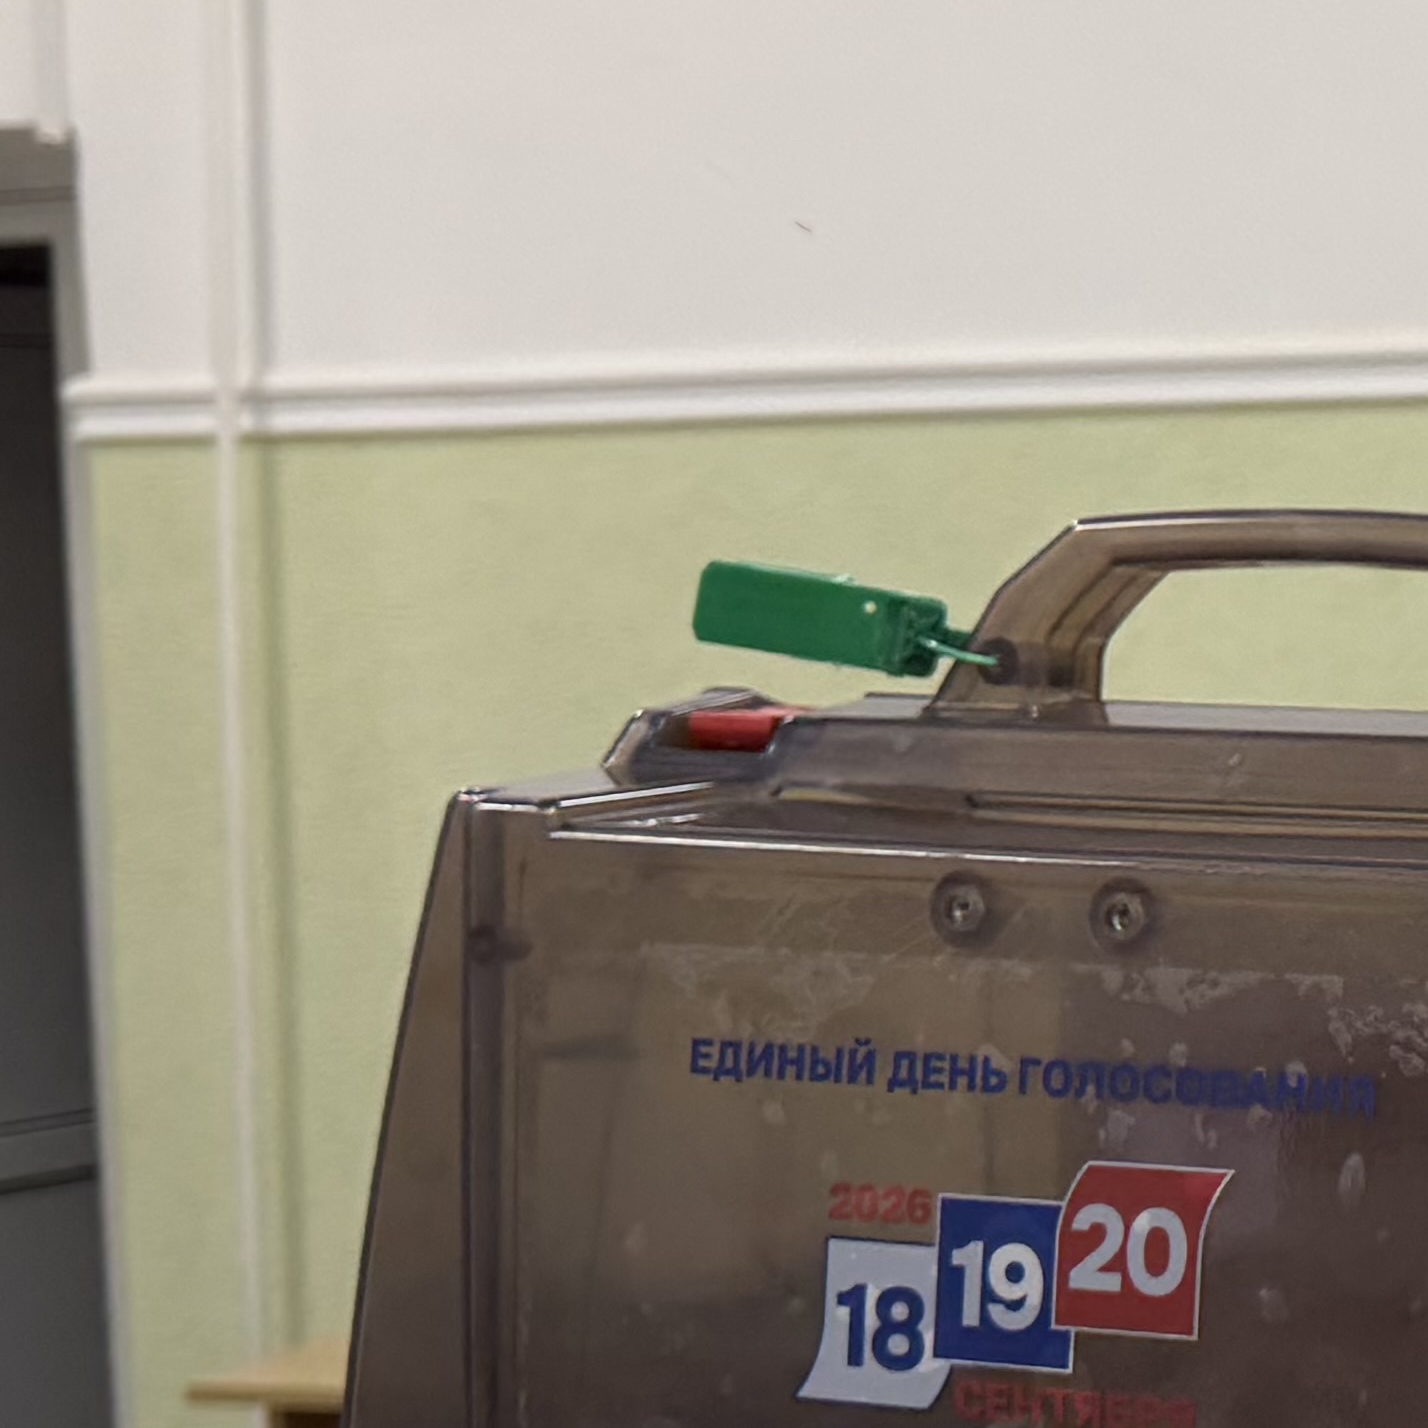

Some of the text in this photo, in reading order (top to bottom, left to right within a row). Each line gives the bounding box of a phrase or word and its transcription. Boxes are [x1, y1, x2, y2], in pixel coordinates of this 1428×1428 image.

[689, 1037, 1377, 1120] ЕДИНЫЙ ДЕНЬ ГОЛОСОВАНИЯ
[828, 1182, 932, 1225] 2026
[836, 1202, 1189, 1372] 18 19 20
